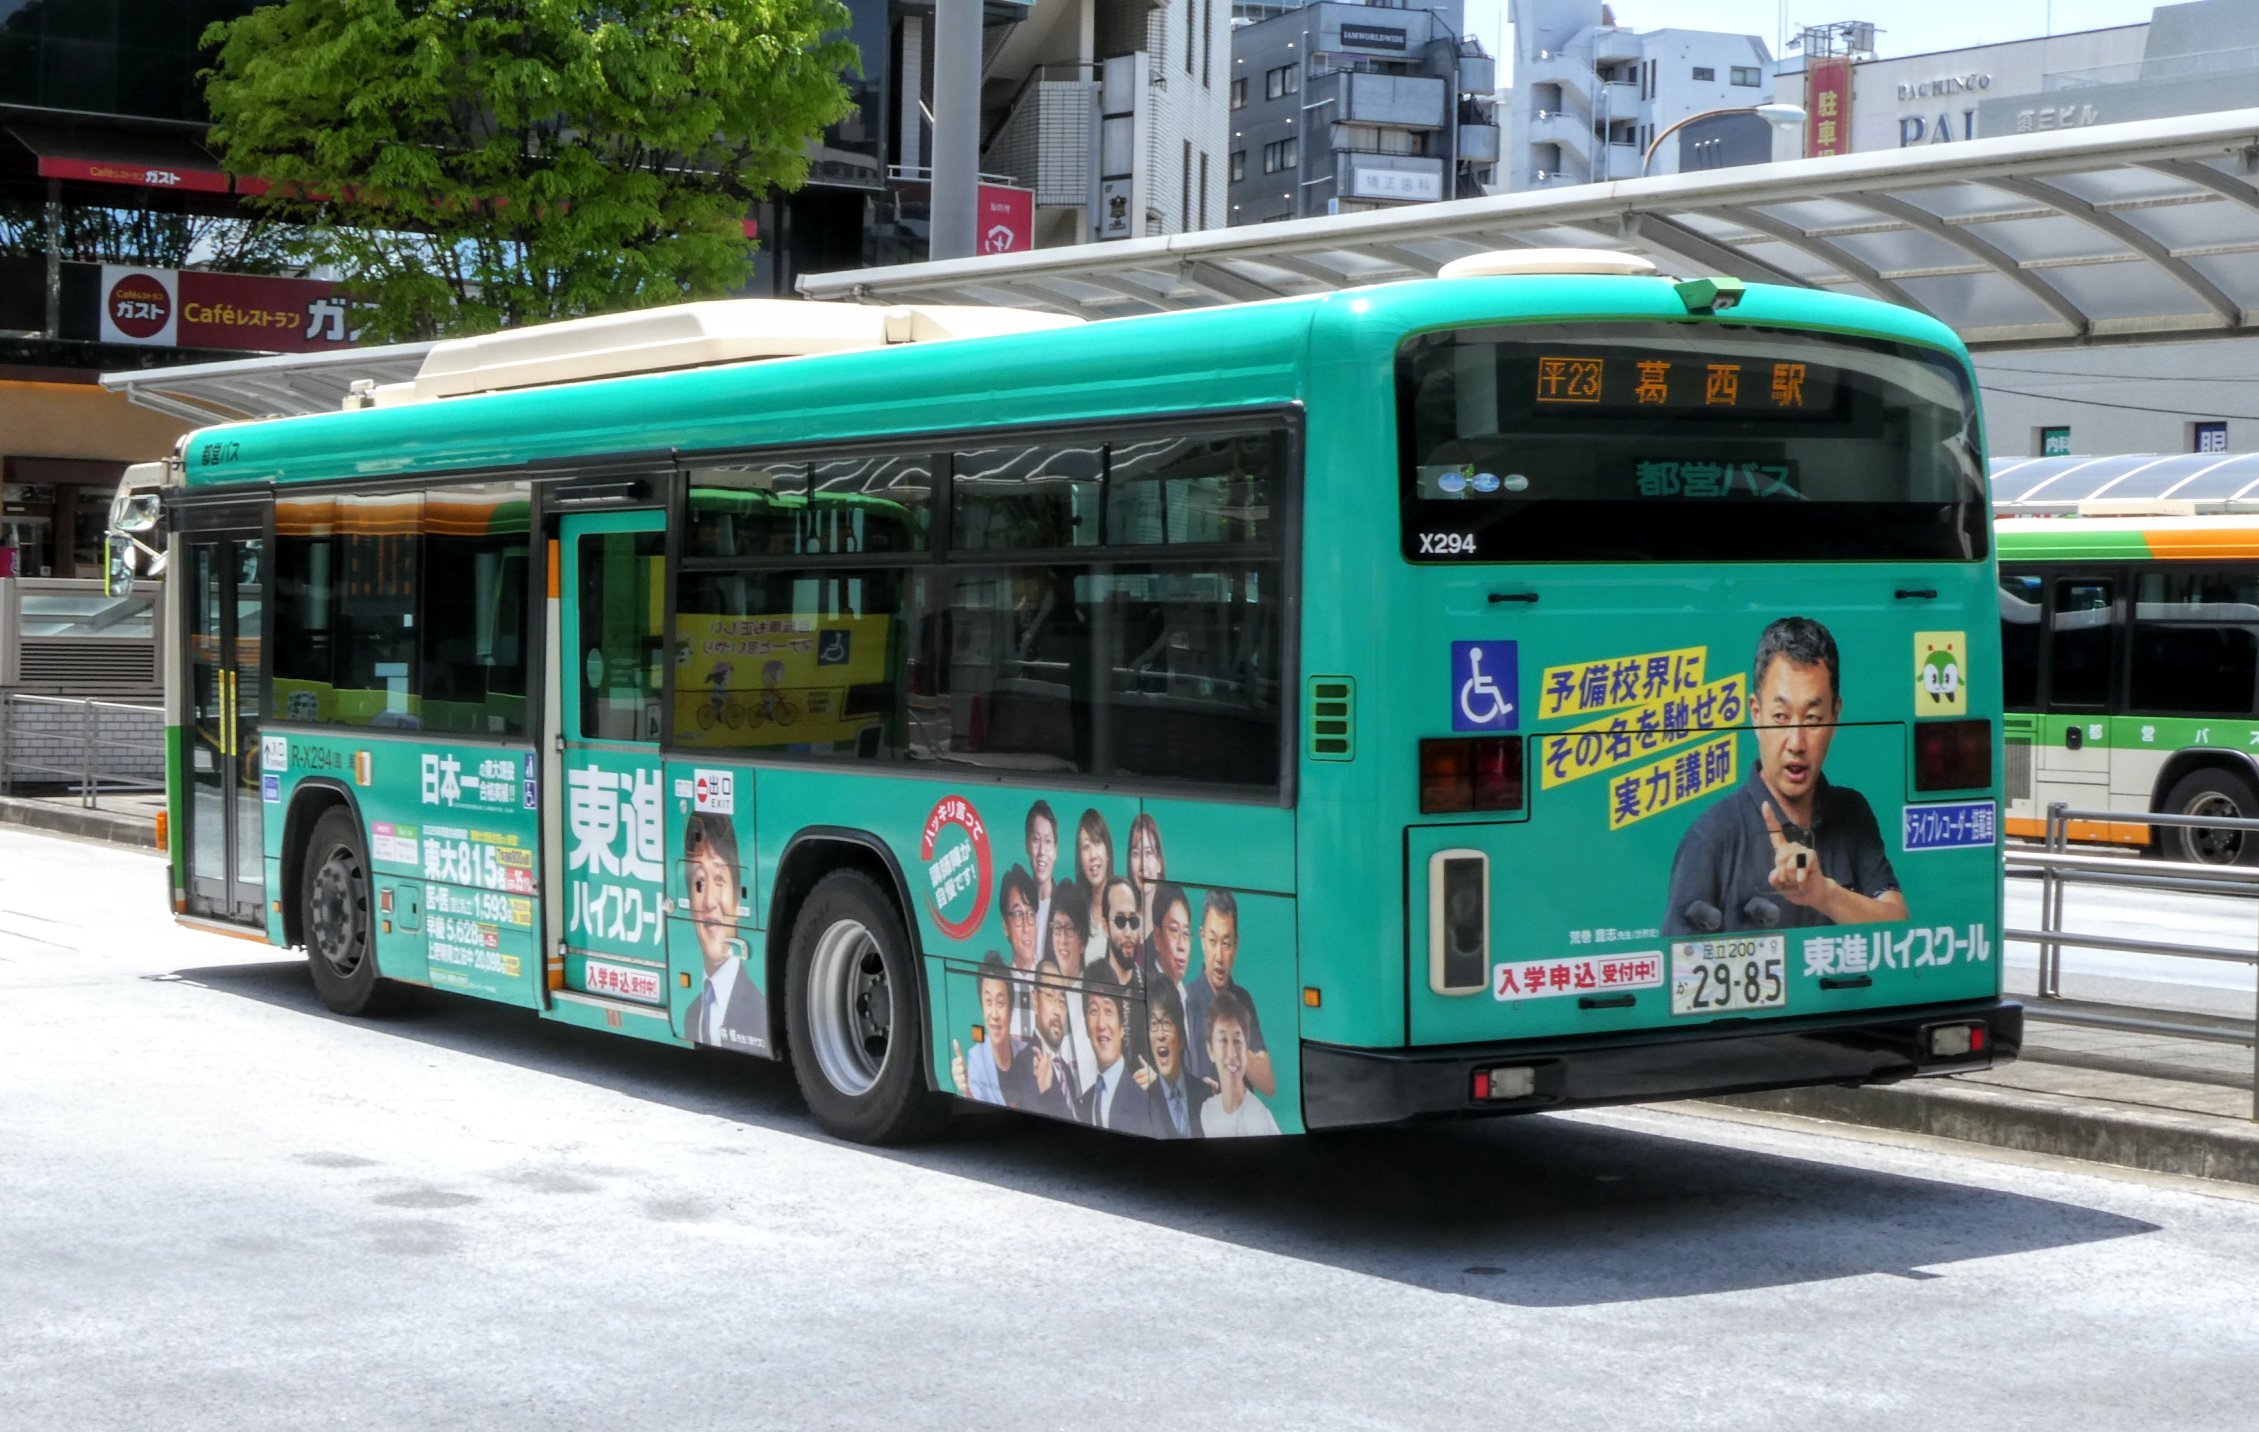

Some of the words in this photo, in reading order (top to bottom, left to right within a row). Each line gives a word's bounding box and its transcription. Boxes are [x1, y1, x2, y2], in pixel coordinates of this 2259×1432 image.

[1898, 73, 1991, 101] PACHINCO
[145, 170, 181, 185] ガスト
[117, 301, 165, 320] ガスト
[184, 303, 299, 328] Caféレストラン
[1542, 360, 1600, 397] 平23
[1634, 359, 1806, 407] 葛西駅
[1636, 460, 1799, 498] 都営バス
[1419, 533, 1477, 555] X294
[1545, 654, 1701, 715] 予備校界に
[1545, 681, 1742, 779] その名を馳せる
[292, 745, 332, 769] R-X294
[421, 753, 480, 807] 日本一
[709, 775, 731, 795] 出口
[1614, 739, 1731, 821] 実力講師
[712, 798, 730, 808] EXIT
[568, 764, 664, 884] 東進
[924, 800, 983, 848] ハッキリ言って
[1803, 922, 1990, 977] 東進ハイスクール
[588, 966, 630, 993] 入学申込
[1497, 963, 1596, 996] 入学申込
[1602, 956, 1657, 986] 受付中!
[1676, 980, 1688, 995] か
[1692, 959, 1781, 1008] 29-85
